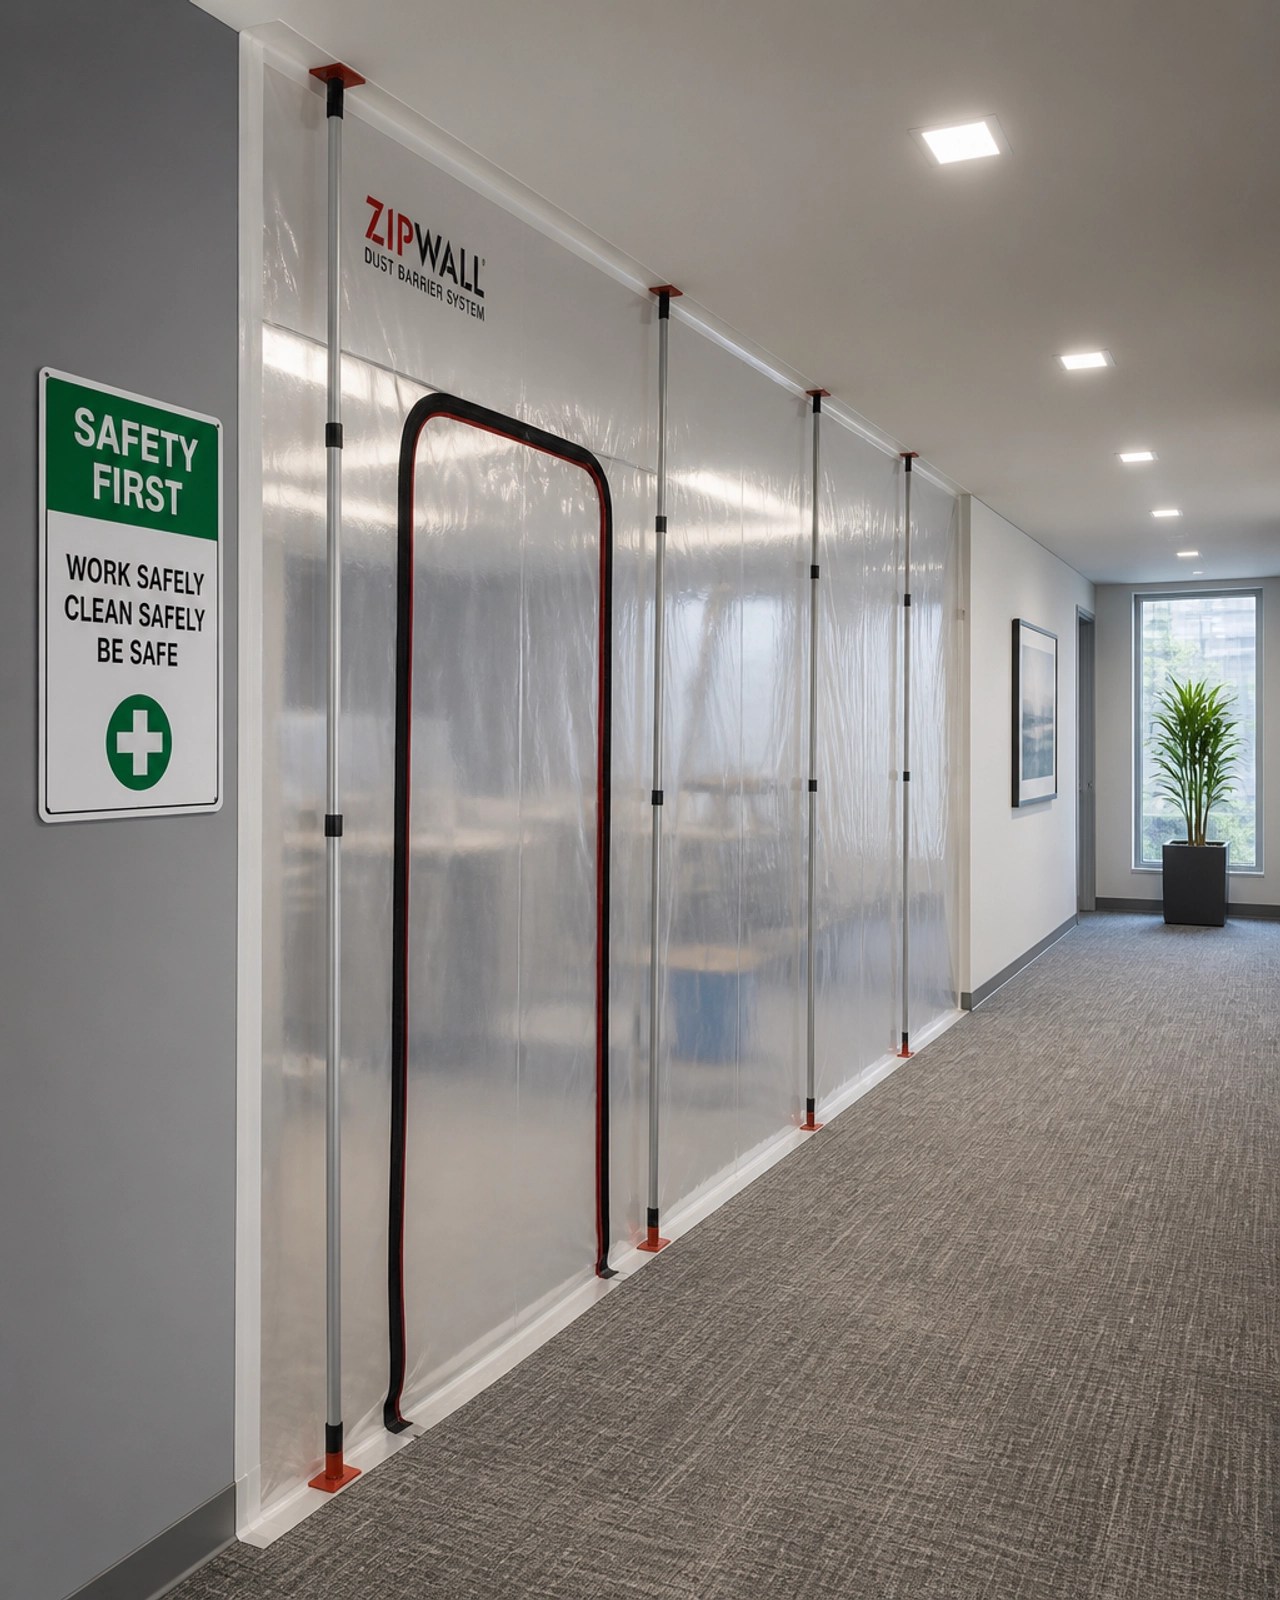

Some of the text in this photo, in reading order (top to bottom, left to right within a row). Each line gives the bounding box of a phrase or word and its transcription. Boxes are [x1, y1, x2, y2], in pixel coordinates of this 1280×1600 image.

[365, 246, 485, 321] DUST BARRIER SYSTEM
[74, 407, 198, 472] SAFETY
[93, 462, 183, 516] FIRST
[66, 553, 204, 596] WORK SAFELY
[64, 594, 205, 632] CLEAN SAFELY
[97, 637, 178, 666] BE SAFE
